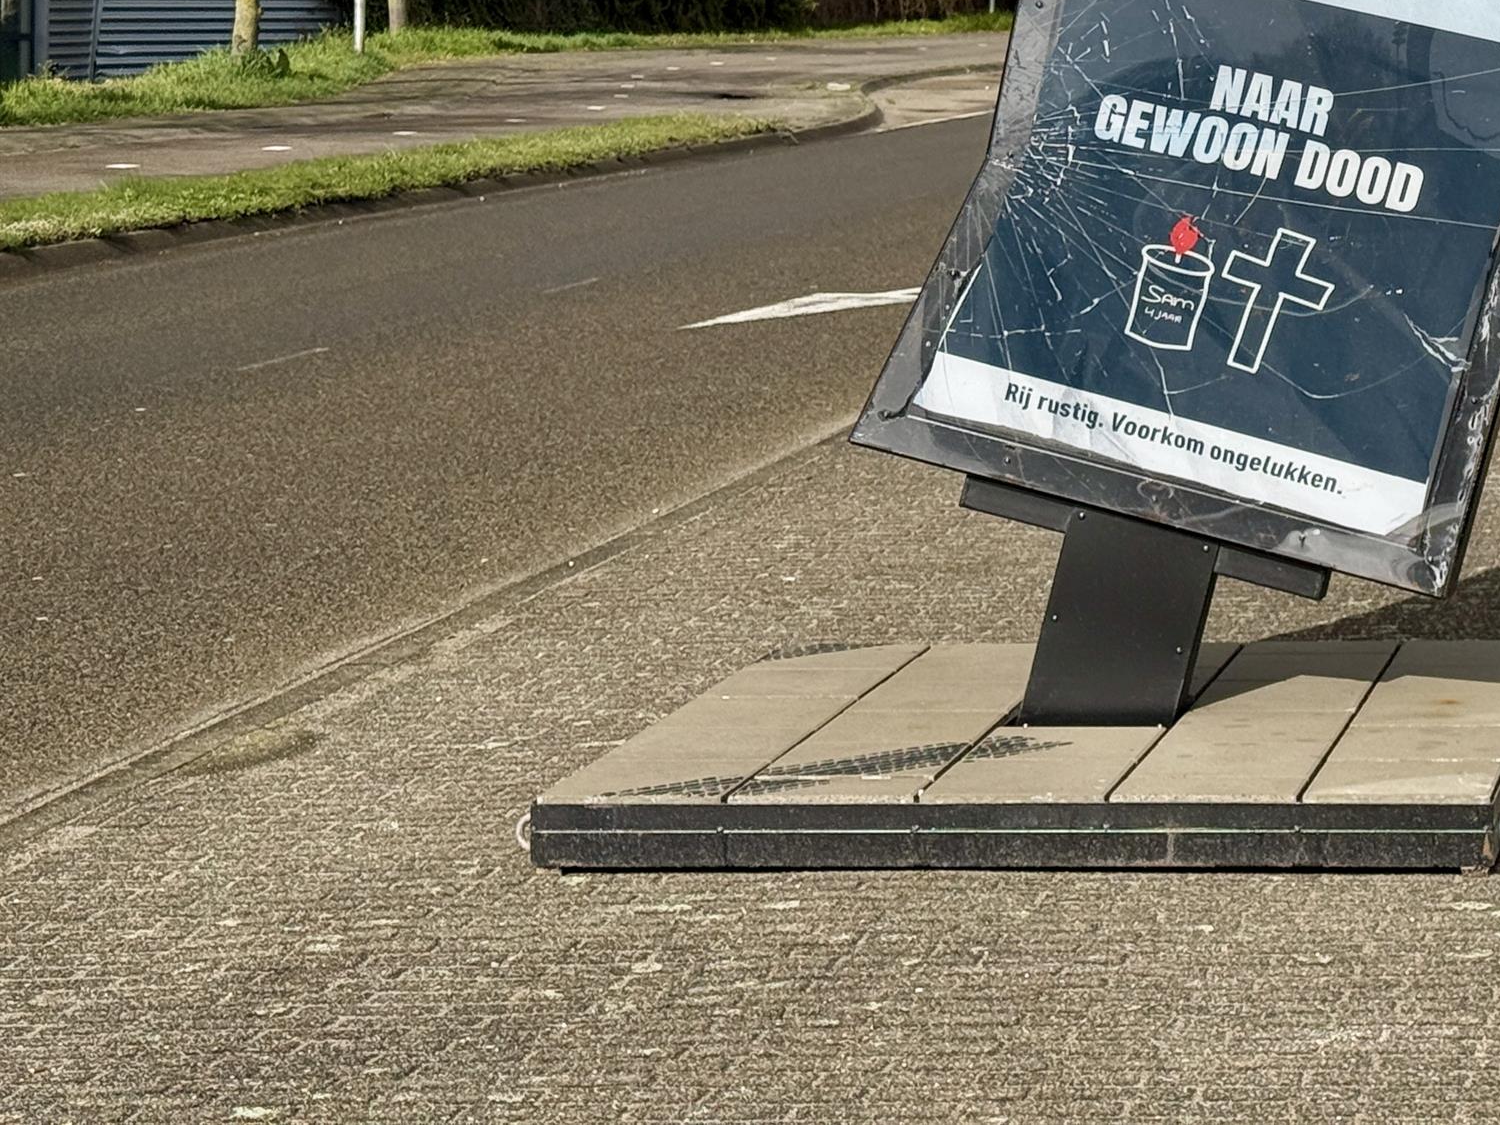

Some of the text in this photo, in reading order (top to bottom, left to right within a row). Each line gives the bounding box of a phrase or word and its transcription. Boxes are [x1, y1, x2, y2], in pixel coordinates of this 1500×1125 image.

[1094, 94, 1424, 213] GEWOON DOOD
[1209, 64, 1334, 137] NAAR
[1004, 382, 1344, 495] Rij rustig. Voorkom ongelukken.
